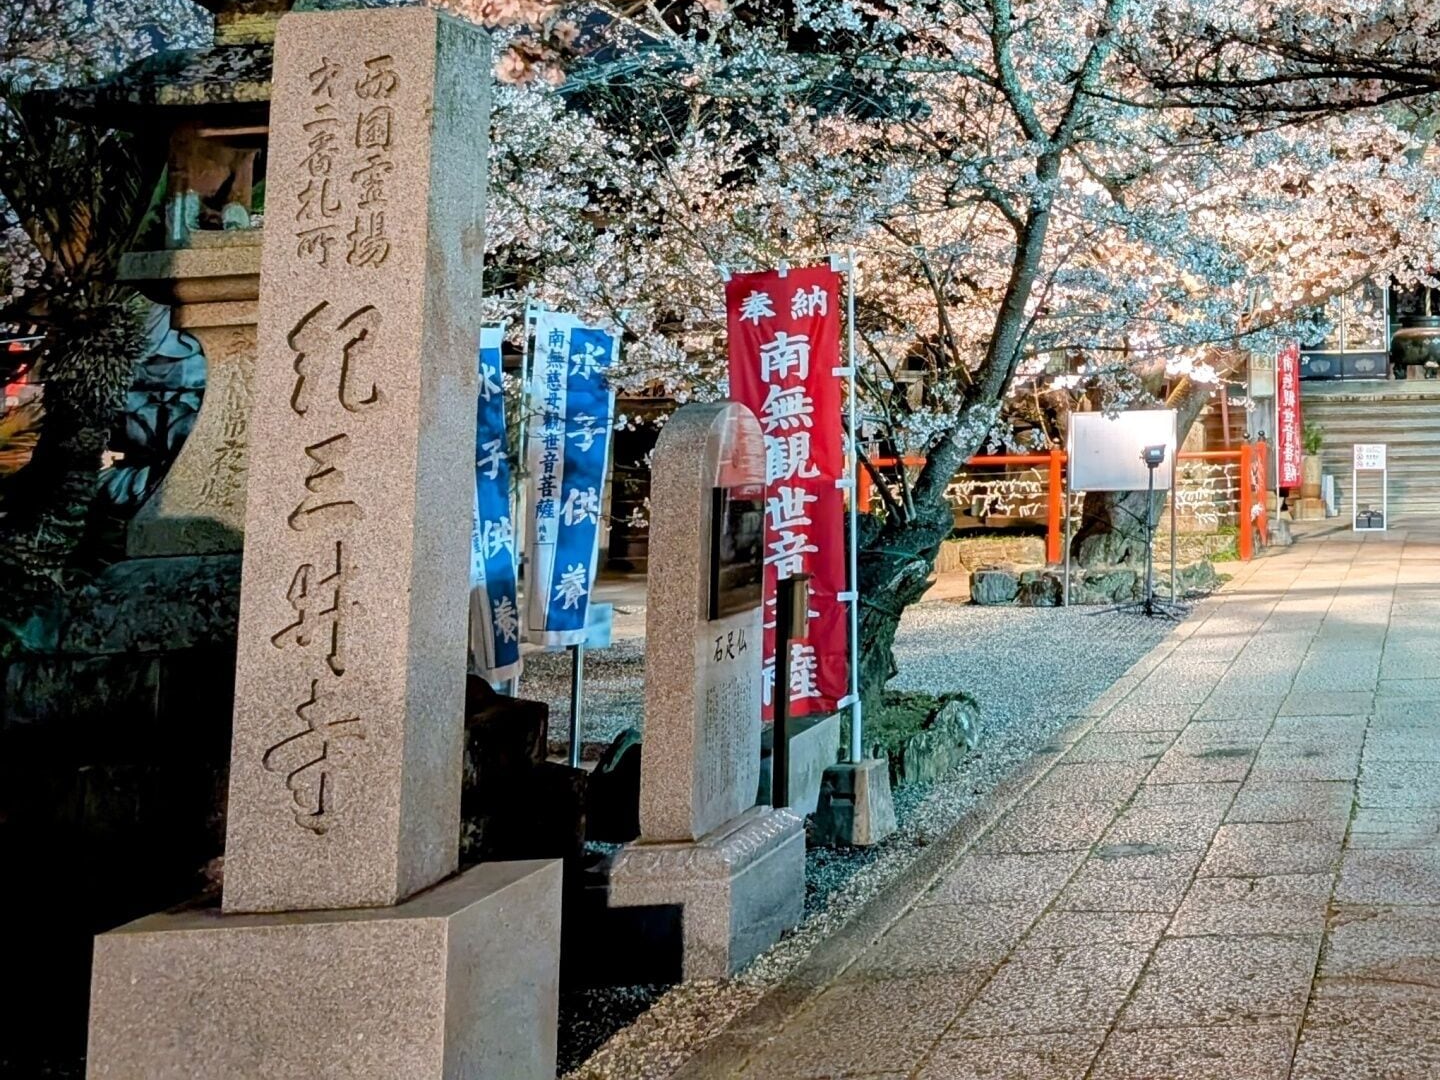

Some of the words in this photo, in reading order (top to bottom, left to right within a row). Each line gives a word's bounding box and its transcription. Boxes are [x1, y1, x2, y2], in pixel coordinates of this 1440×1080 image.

[738, 284, 829, 326] 奉納
[261, 300, 383, 836] 紀三井寺
[476, 362, 518, 644] 水子供養
[553, 341, 608, 610] 水子供養
[760, 331, 823, 706] 南無観世音薩
